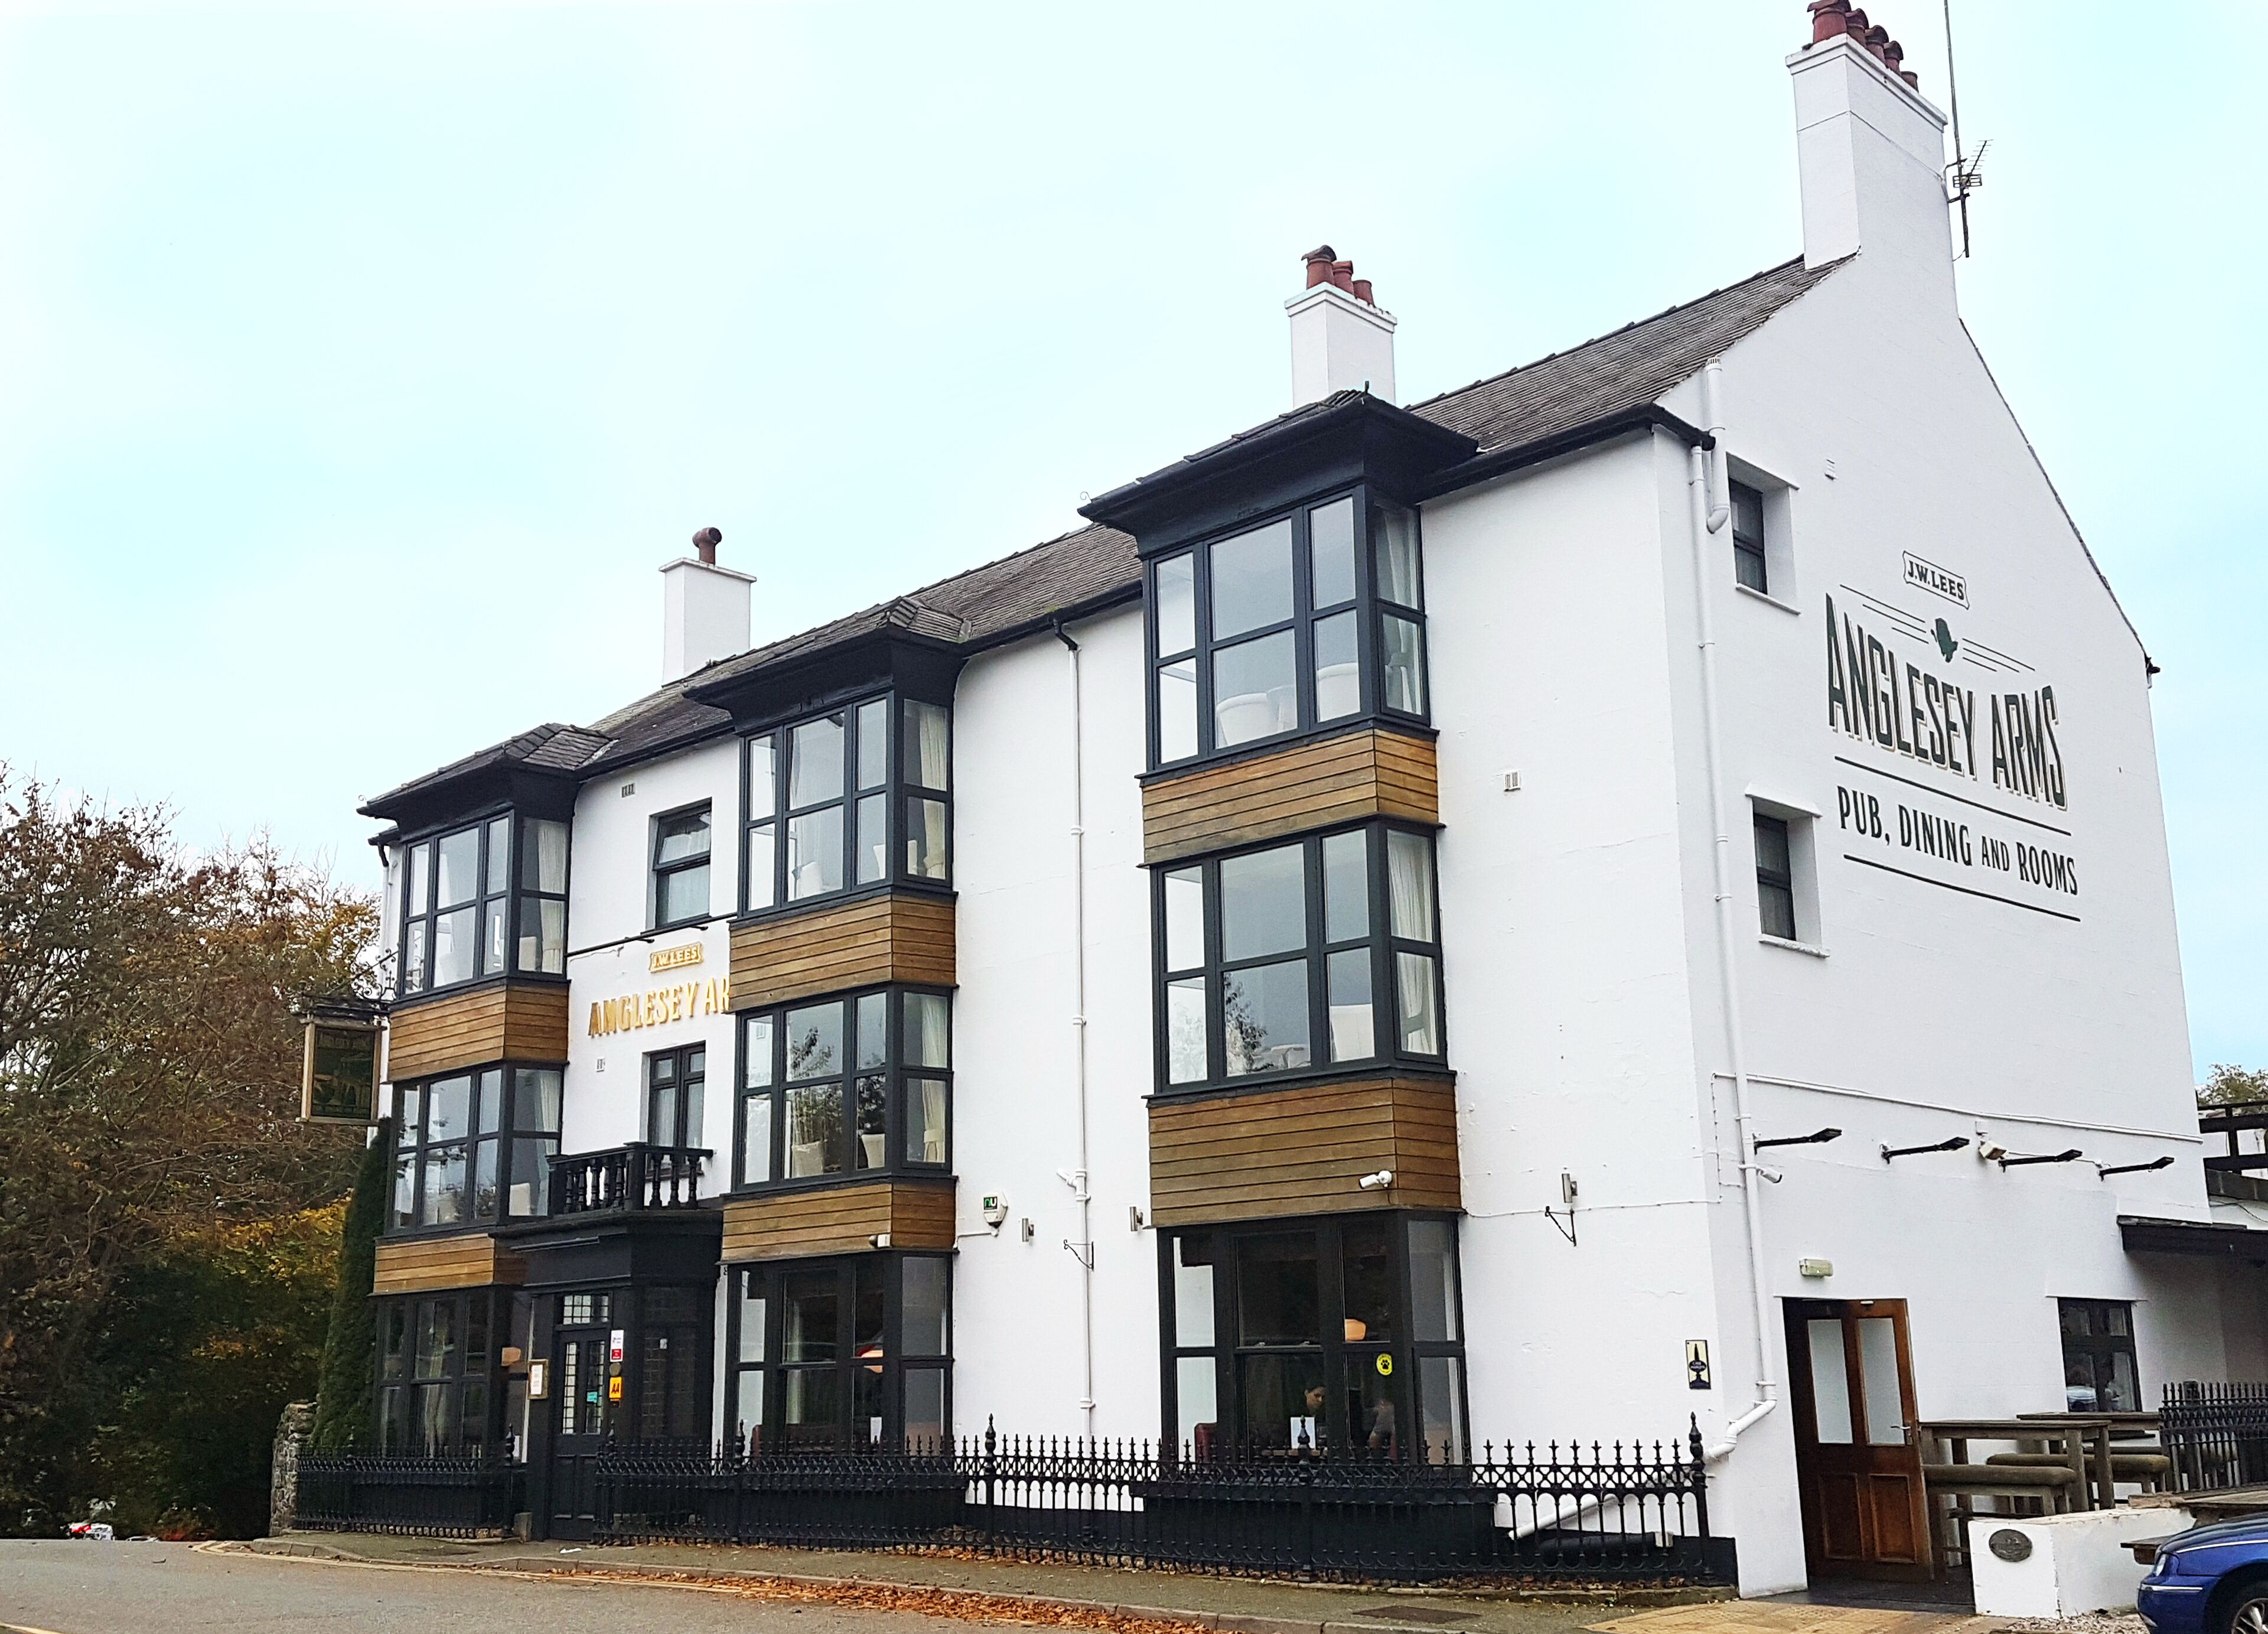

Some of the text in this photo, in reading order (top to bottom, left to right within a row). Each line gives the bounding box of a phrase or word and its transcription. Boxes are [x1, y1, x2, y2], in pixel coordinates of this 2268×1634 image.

[1908, 560, 1964, 600] J.W.LEES
[1826, 593, 2068, 811] ANGLESEY ARMS
[1837, 786, 2078, 896] PUB, DINING AND ROOMS
[588, 982, 699, 1037] ANGLESEY
